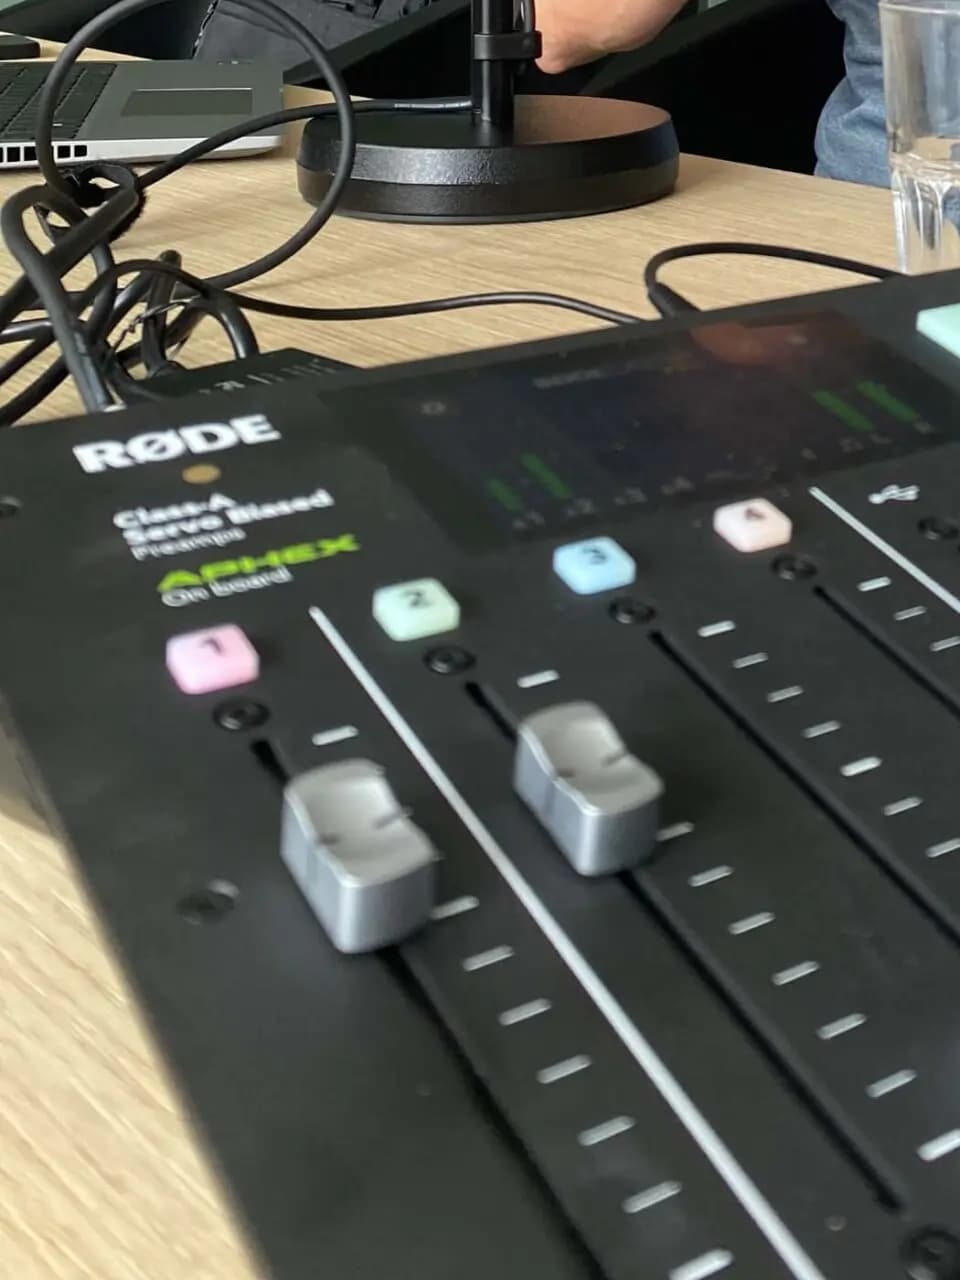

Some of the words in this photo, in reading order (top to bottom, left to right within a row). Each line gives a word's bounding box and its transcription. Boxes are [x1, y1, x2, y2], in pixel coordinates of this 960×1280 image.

[73, 414, 281, 472] RØDE
[156, 533, 361, 593] APHEX
[581, 546, 608, 566] 3
[399, 591, 436, 609] 2
[199, 637, 226, 657] 1
